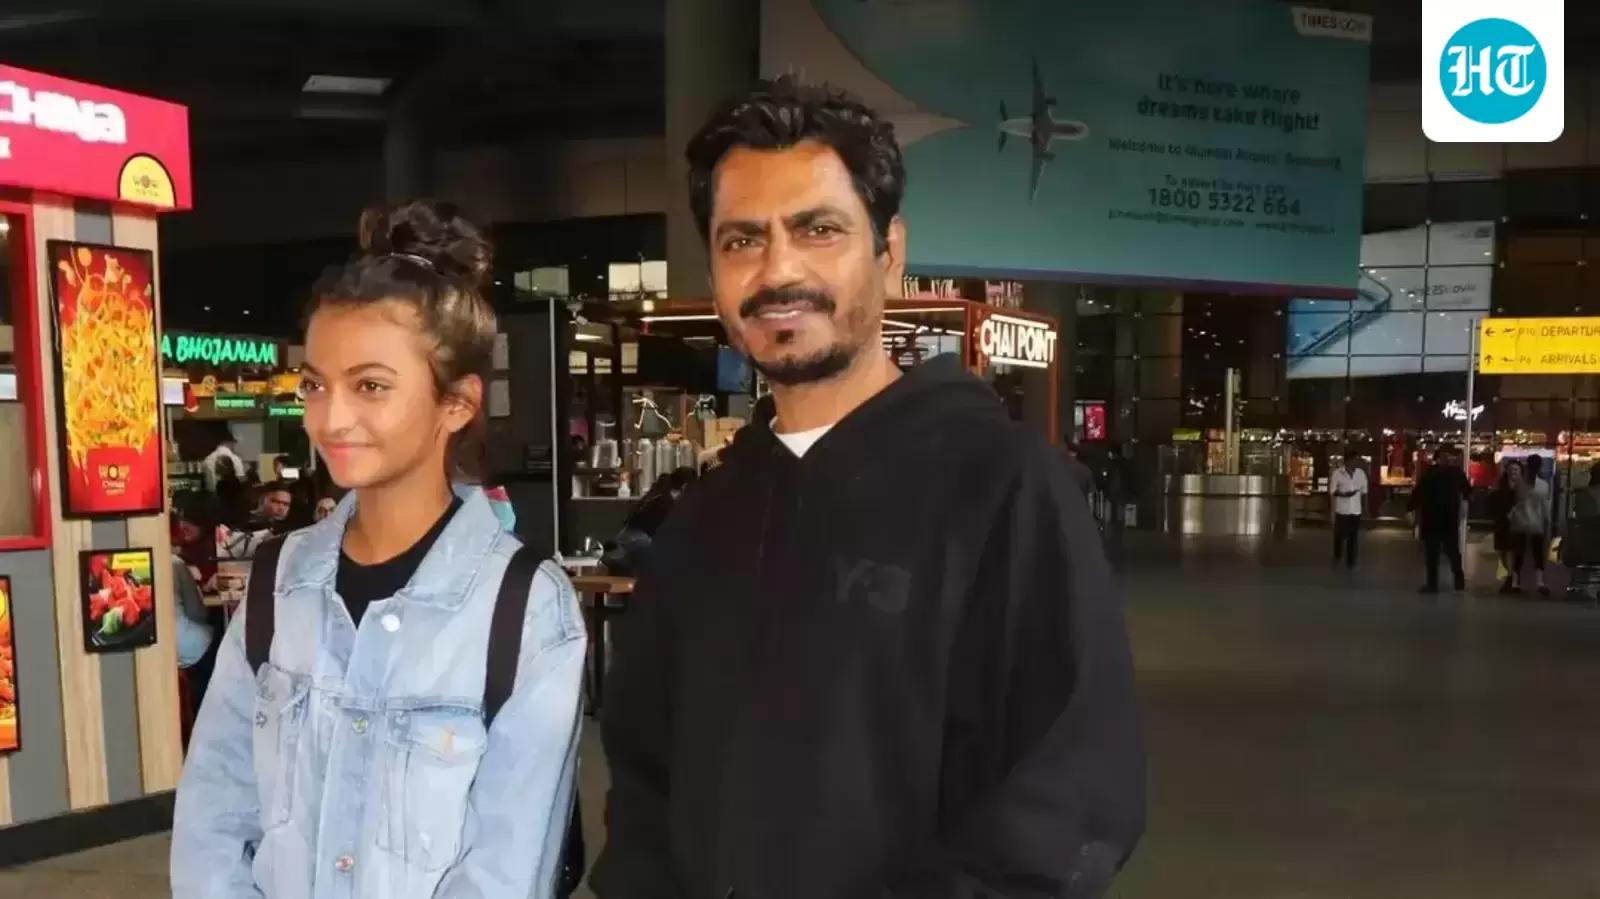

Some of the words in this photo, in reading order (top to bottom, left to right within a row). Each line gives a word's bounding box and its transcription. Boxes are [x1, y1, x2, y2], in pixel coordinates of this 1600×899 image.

[1158, 72, 1188, 93] It's
[1136, 94, 1210, 120] dreams
[1149, 188, 1201, 209] 1800
[1208, 192, 1256, 213] 5322
[1263, 196, 1301, 216] 664
[175, 335, 279, 366] BHOJANAM
[979, 318, 1016, 358] CHAI
[1017, 325, 1057, 363] POINT
[1540, 353, 1597, 366] ARRIVALS
